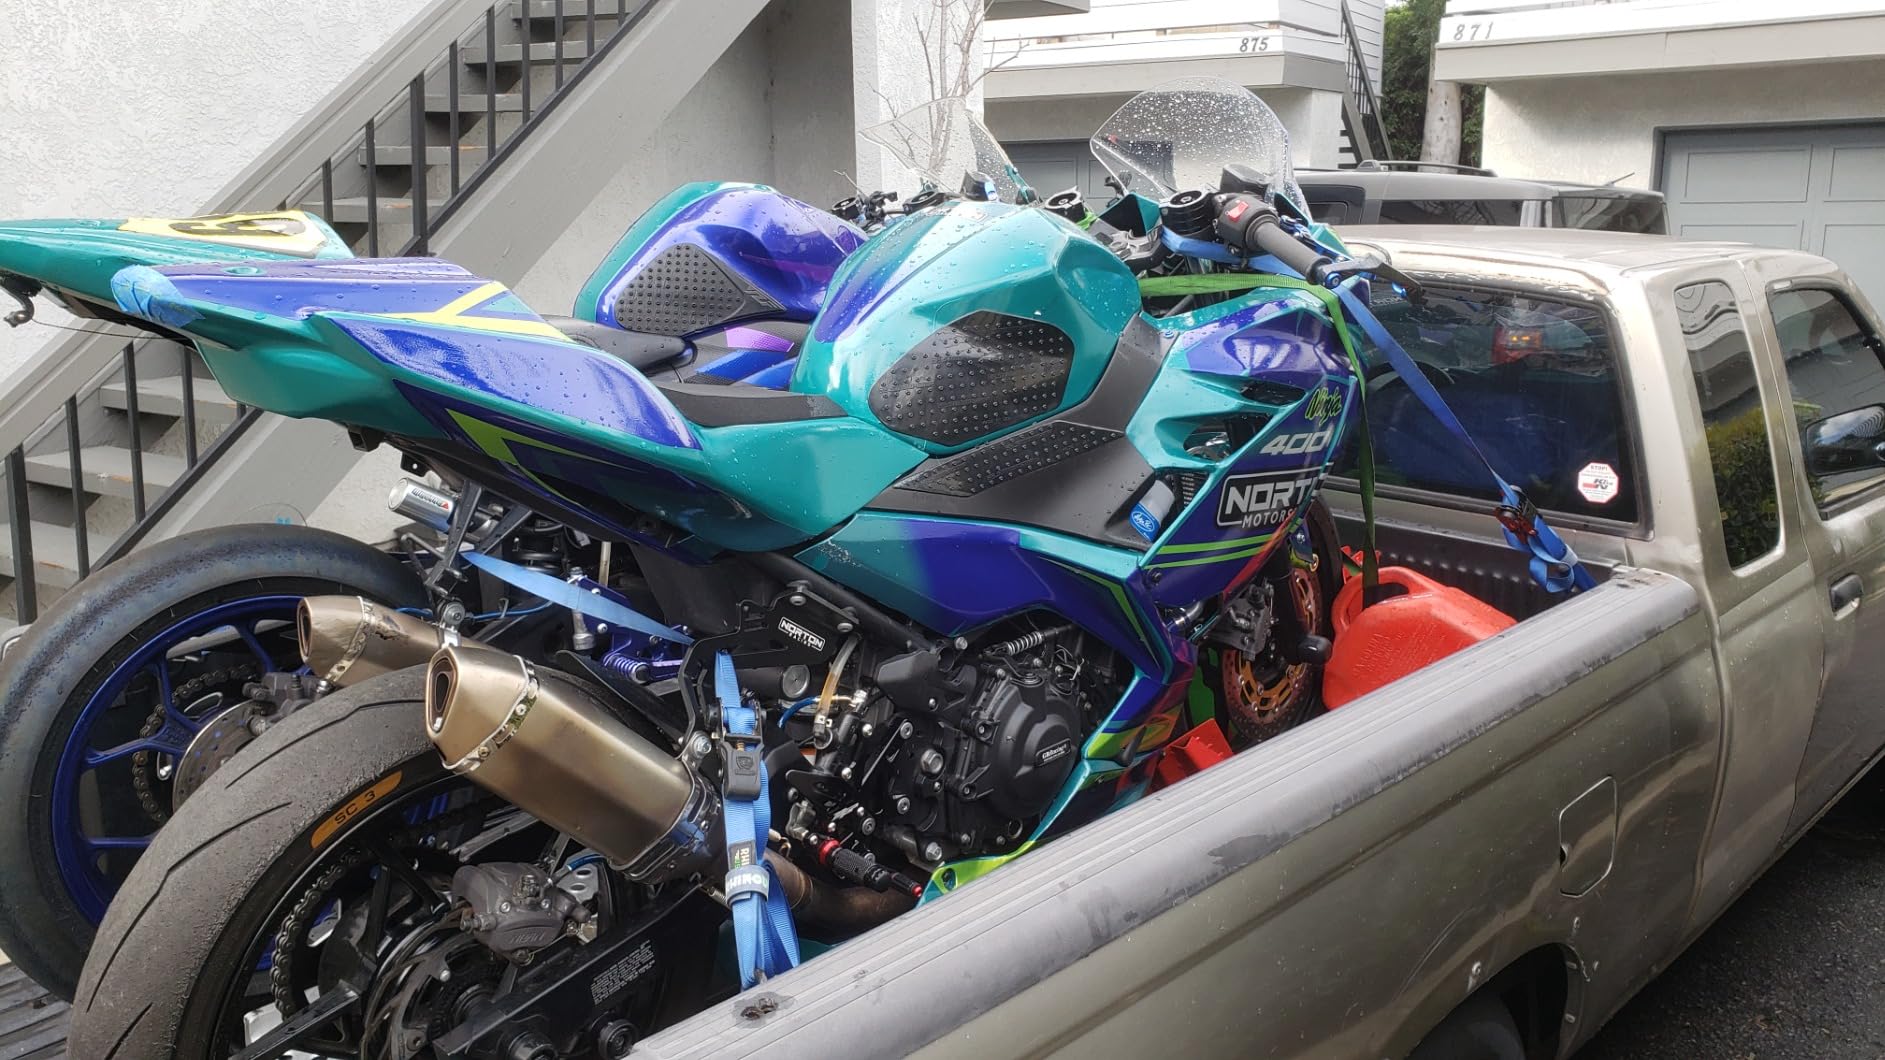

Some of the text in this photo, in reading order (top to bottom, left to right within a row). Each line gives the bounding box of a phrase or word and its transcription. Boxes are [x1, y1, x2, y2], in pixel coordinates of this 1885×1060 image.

[1453, 21, 1494, 41] 871
[1239, 37, 1270, 53] 875
[1304, 386, 1343, 427] Ninja
[1259, 430, 1331, 456] 400
[1225, 477, 1317, 515] NORT
[1242, 508, 1298, 529] MOTORS
[780, 620, 823, 648] NORTON
[335, 790, 376, 825] SC 3
[741, 847, 750, 866] RHI
